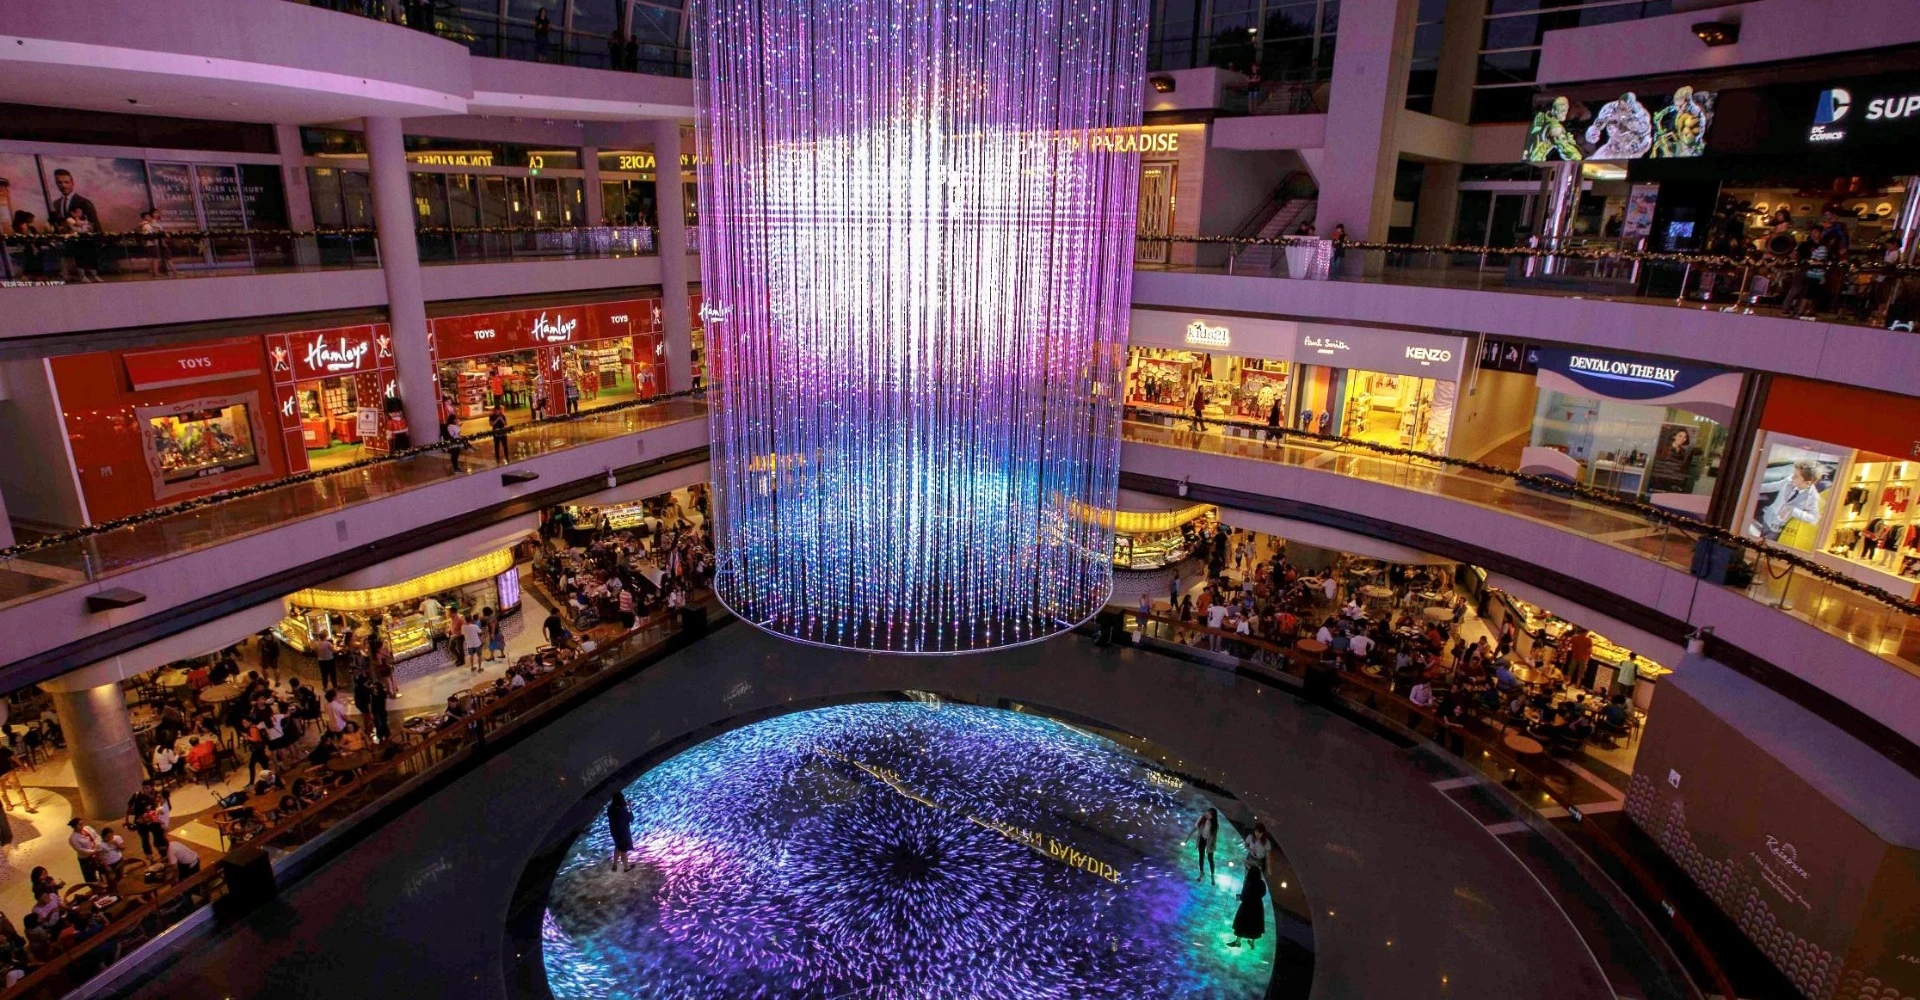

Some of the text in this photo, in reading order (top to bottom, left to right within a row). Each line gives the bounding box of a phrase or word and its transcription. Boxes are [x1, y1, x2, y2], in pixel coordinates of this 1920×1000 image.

[1091, 132, 1179, 152] PARADISE
[531, 311, 577, 342] Hamleys
[611, 314, 629, 324] TOYS
[473, 328, 496, 340] TOYS
[1304, 335, 1351, 350] Paul Smith
[303, 333, 368, 371] Hamleys
[1405, 345, 1452, 362] KENZO
[177, 356, 213, 370] TOYS
[1569, 355, 1680, 382] DENTAL ON THE BAY
